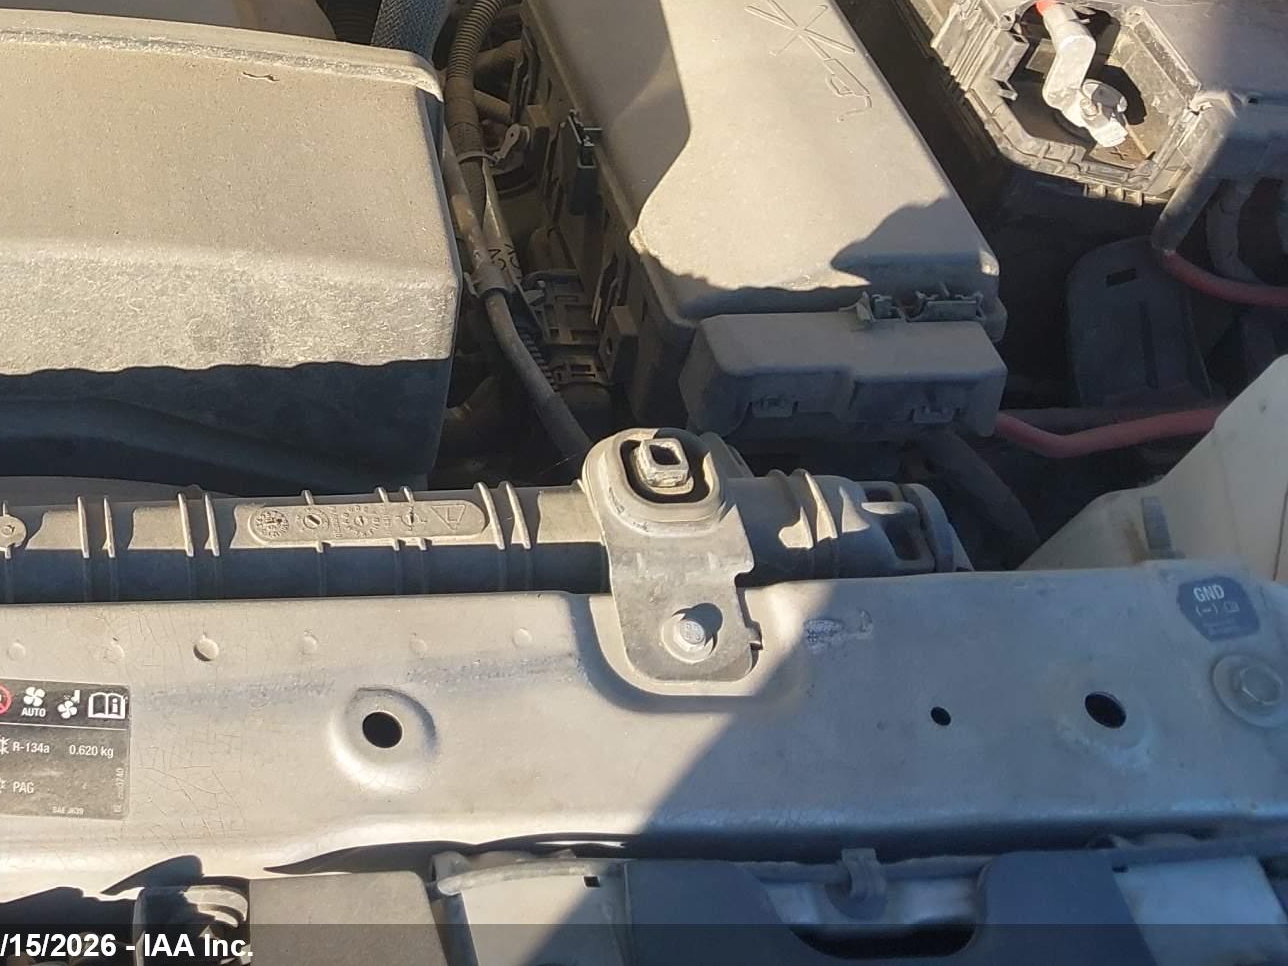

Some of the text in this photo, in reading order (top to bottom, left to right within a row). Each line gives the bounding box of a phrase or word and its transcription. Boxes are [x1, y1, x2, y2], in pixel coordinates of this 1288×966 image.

[1193, 584, 1225, 603] GND
[21, 707, 46, 718] AUTO
[12, 741, 114, 759] R-134a 0.620 kg
[12, 781, 35, 794] PAG
